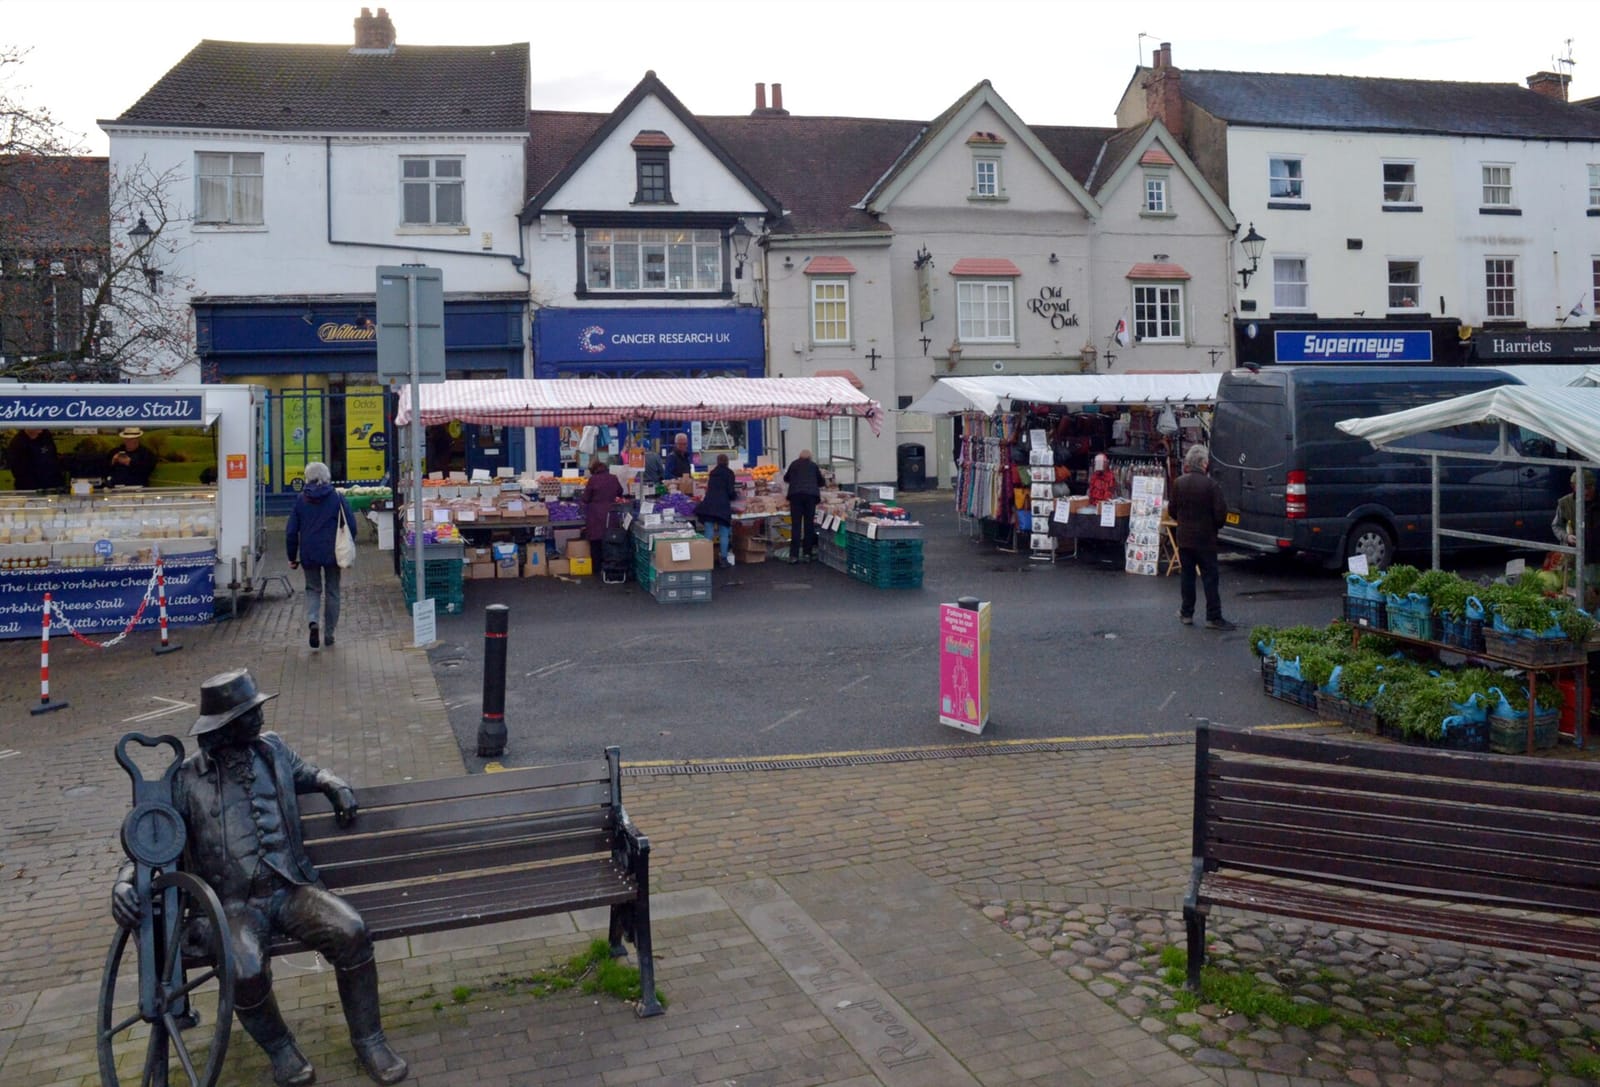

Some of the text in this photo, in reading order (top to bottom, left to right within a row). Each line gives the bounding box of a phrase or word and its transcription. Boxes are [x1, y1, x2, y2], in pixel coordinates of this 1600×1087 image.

[1040, 286, 1063, 300] Old
[1027, 298, 1071, 318] Royal
[1050, 313, 1079, 330] Oak
[319, 323, 376, 341] William
[611, 333, 731, 344] CANCER RESEARCH UK
[1303, 335, 1405, 357] Supernews
[1493, 338, 1552, 353] Harriets
[66, 400, 139, 418] Cheese
[141, 399, 193, 418] Stall
[1, 583, 25, 593] The
[26, 581, 60, 591] Little
[62, 578, 119, 590] Yorkshire
[0, 602, 45, 614] orkshir
[94, 598, 124, 610] Stall
[168, 595, 199, 606] Little
[833, 998, 936, 1070] Road
